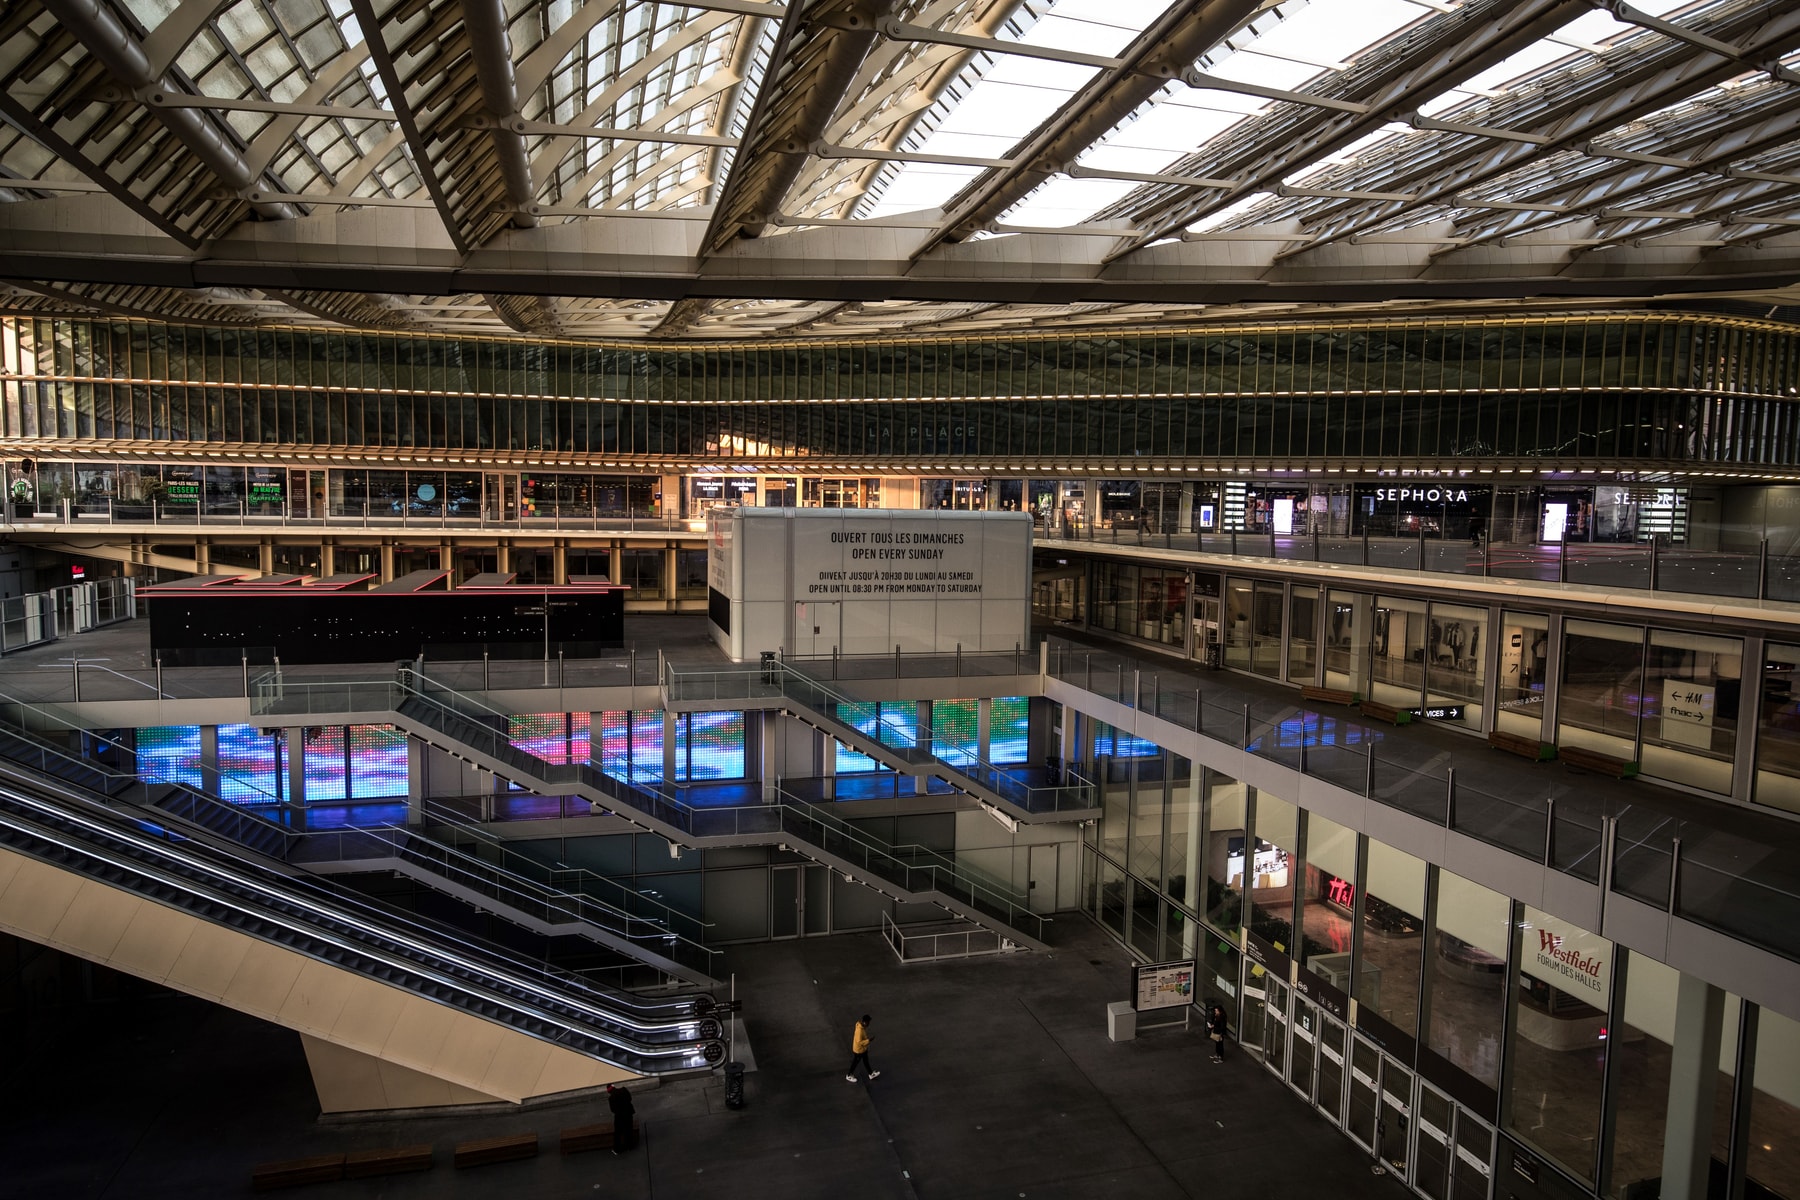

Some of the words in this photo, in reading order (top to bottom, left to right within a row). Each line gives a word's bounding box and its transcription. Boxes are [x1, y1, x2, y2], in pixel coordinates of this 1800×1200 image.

[869, 427, 890, 437] LA
[910, 427, 975, 437] PLACE
[1377, 489, 1467, 502] SEPHORA
[831, 532, 867, 543] OUVERT
[870, 532, 893, 544] TOUS
[896, 533, 911, 544] LES
[913, 533, 964, 545] DIMANCHES
[852, 548, 876, 559] OPEN
[879, 548, 906, 559] EVERY
[908, 548, 944, 559] SUNDAY
[819, 571, 847, 580] OUVERT
[849, 569, 879, 581] JUSQU'À
[881, 571, 902, 580] 20H30
[904, 571, 913, 580] DU
[915, 571, 936, 580] LUNDI
[937, 571, 947, 580] AU
[948, 571, 973, 580] SAMEDI
[809, 584, 828, 593] OPEN
[830, 584, 851, 593] UNTIL
[853, 584, 872, 593] 08:30
[874, 584, 884, 593] PM
[886, 584, 905, 593] FROM
[906, 584, 936, 593] MONDAY
[937, 584, 946, 593] TO
[947, 584, 982, 593] SATURDAY
[1670, 706, 1693, 718] fnac
[1329, 876, 1355, 908] H&
[1537, 929, 1603, 978] Westfield
[1537, 953, 1560, 975] FORUM
[1560, 964, 1574, 979] DES
[1575, 972, 1602, 992] HALLES
